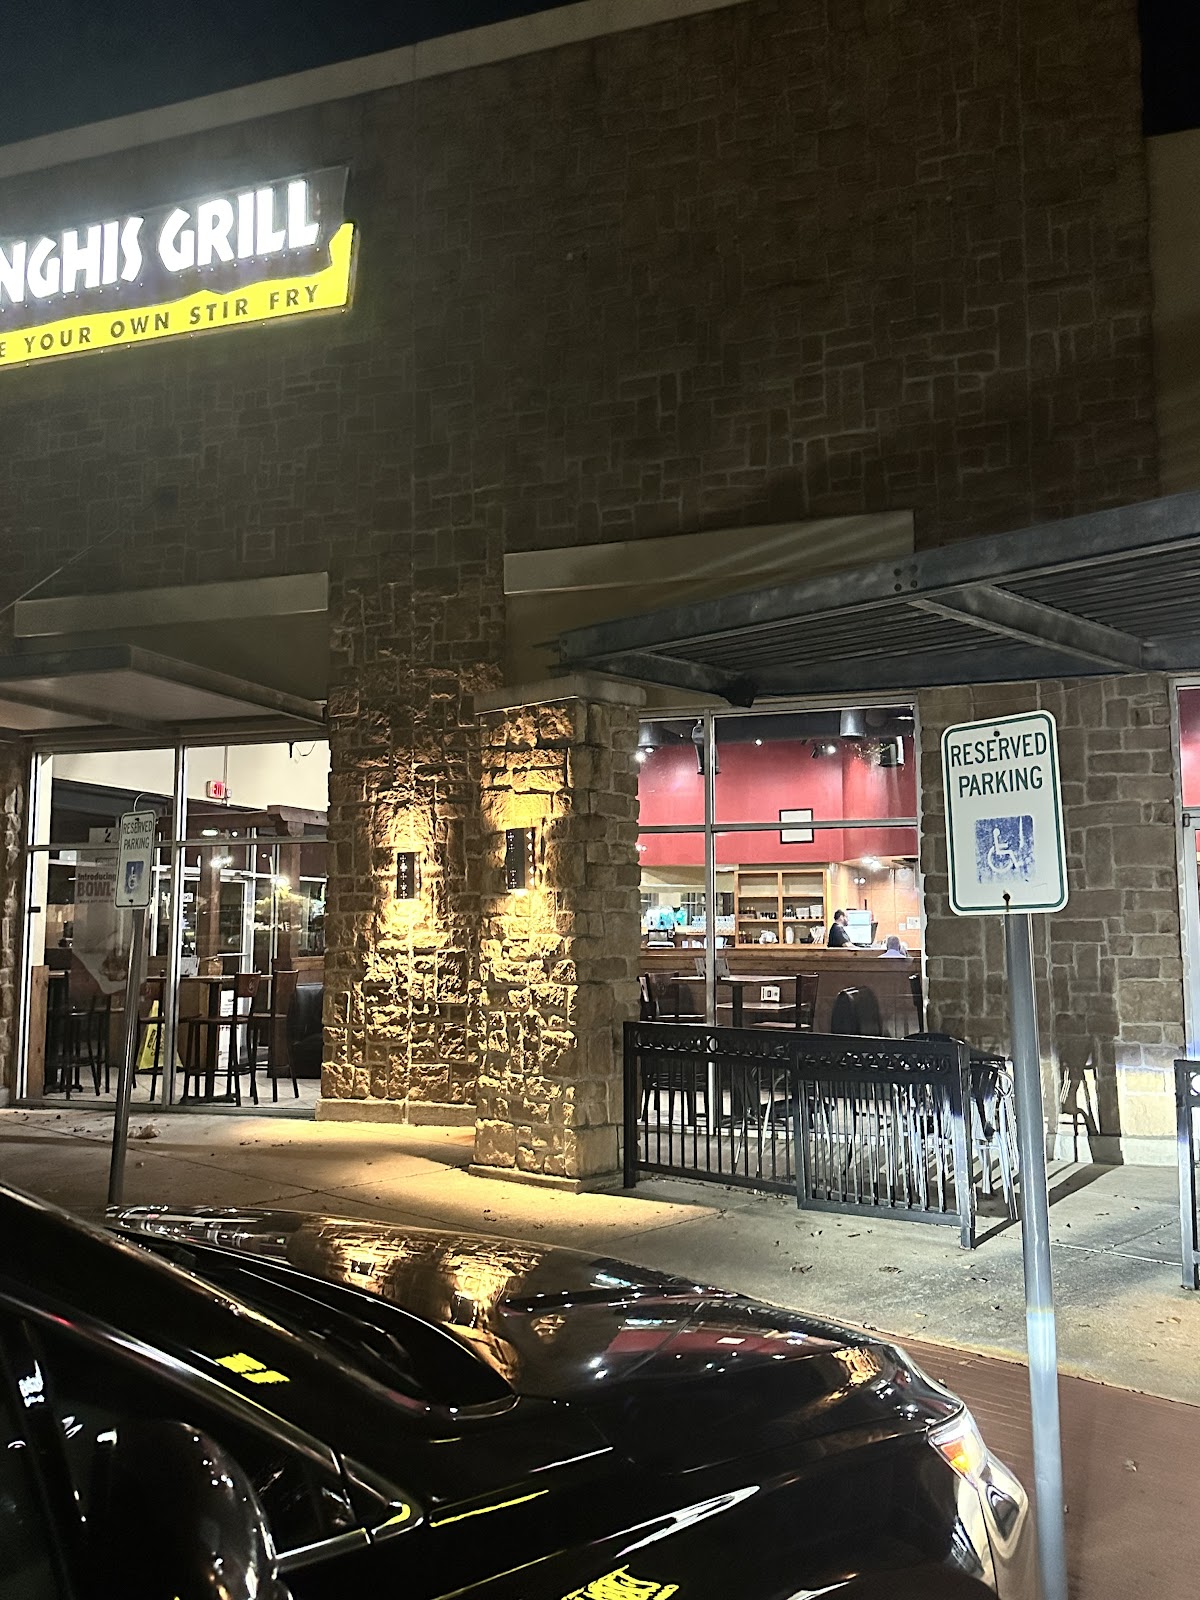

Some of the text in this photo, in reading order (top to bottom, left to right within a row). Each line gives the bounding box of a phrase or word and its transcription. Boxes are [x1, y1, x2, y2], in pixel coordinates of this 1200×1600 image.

[0, 179, 320, 304] NGHIS GRILL
[24, 326, 91, 354] YOUR
[110, 312, 170, 339] OWN
[189, 298, 249, 325] STIR
[269, 284, 319, 311] FRY
[950, 731, 1047, 768] RESERVED
[958, 765, 1043, 798] PARKING
[123, 820, 152, 835] RESERVED
[123, 836, 150, 850] PARKING
